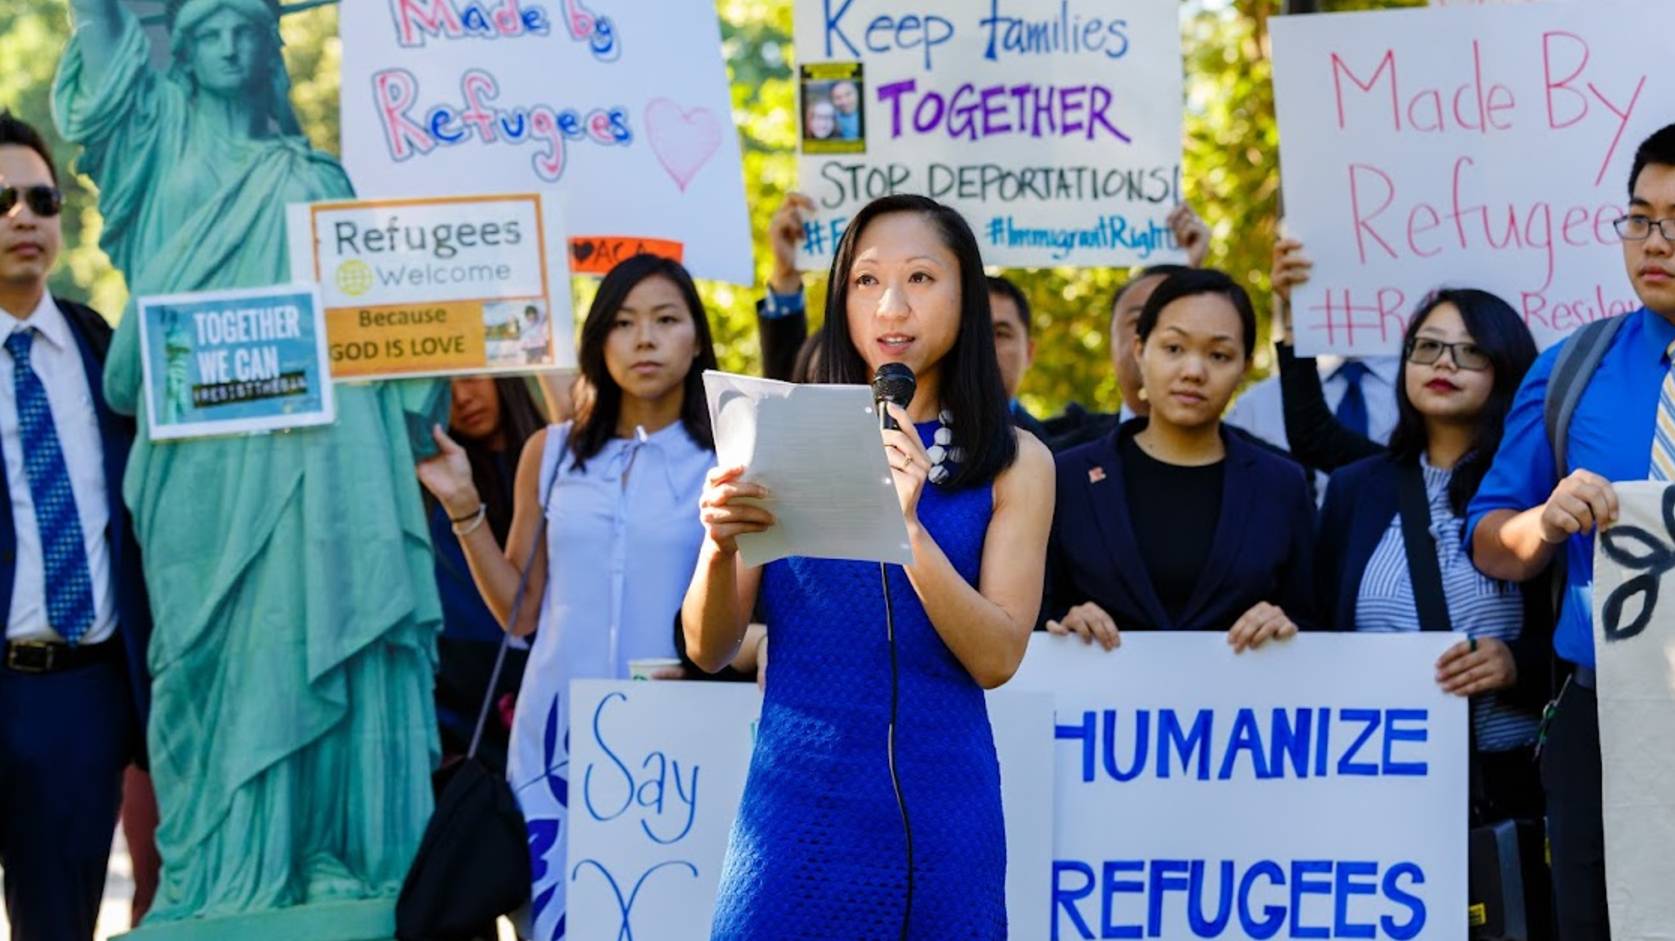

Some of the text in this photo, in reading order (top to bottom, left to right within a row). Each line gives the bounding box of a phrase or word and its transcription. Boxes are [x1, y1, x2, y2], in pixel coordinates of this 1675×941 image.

[392, 0, 550, 47] Made
[825, 0, 1129, 71] Keep families
[372, 68, 634, 183] Refugees
[877, 78, 1131, 143] TOGETHER
[1330, 31, 1647, 187] Made By
[820, 161, 911, 210] STOP
[335, 216, 521, 259] Refugees
[986, 214, 1180, 260] #ImmigrantRight
[1349, 155, 1623, 294] Refugee
[376, 262, 511, 286] Welcome
[193, 305, 300, 346] TOGETHER
[358, 306, 447, 328] Because
[198, 345, 279, 384] WE CAN
[330, 342, 378, 362] GOD
[385, 340, 404, 358] IS
[411, 336, 465, 356] LOVE
[584, 691, 699, 844] Say
[1054, 707, 1429, 782] HUMANIZE
[1051, 859, 1427, 941] REFUGEES
